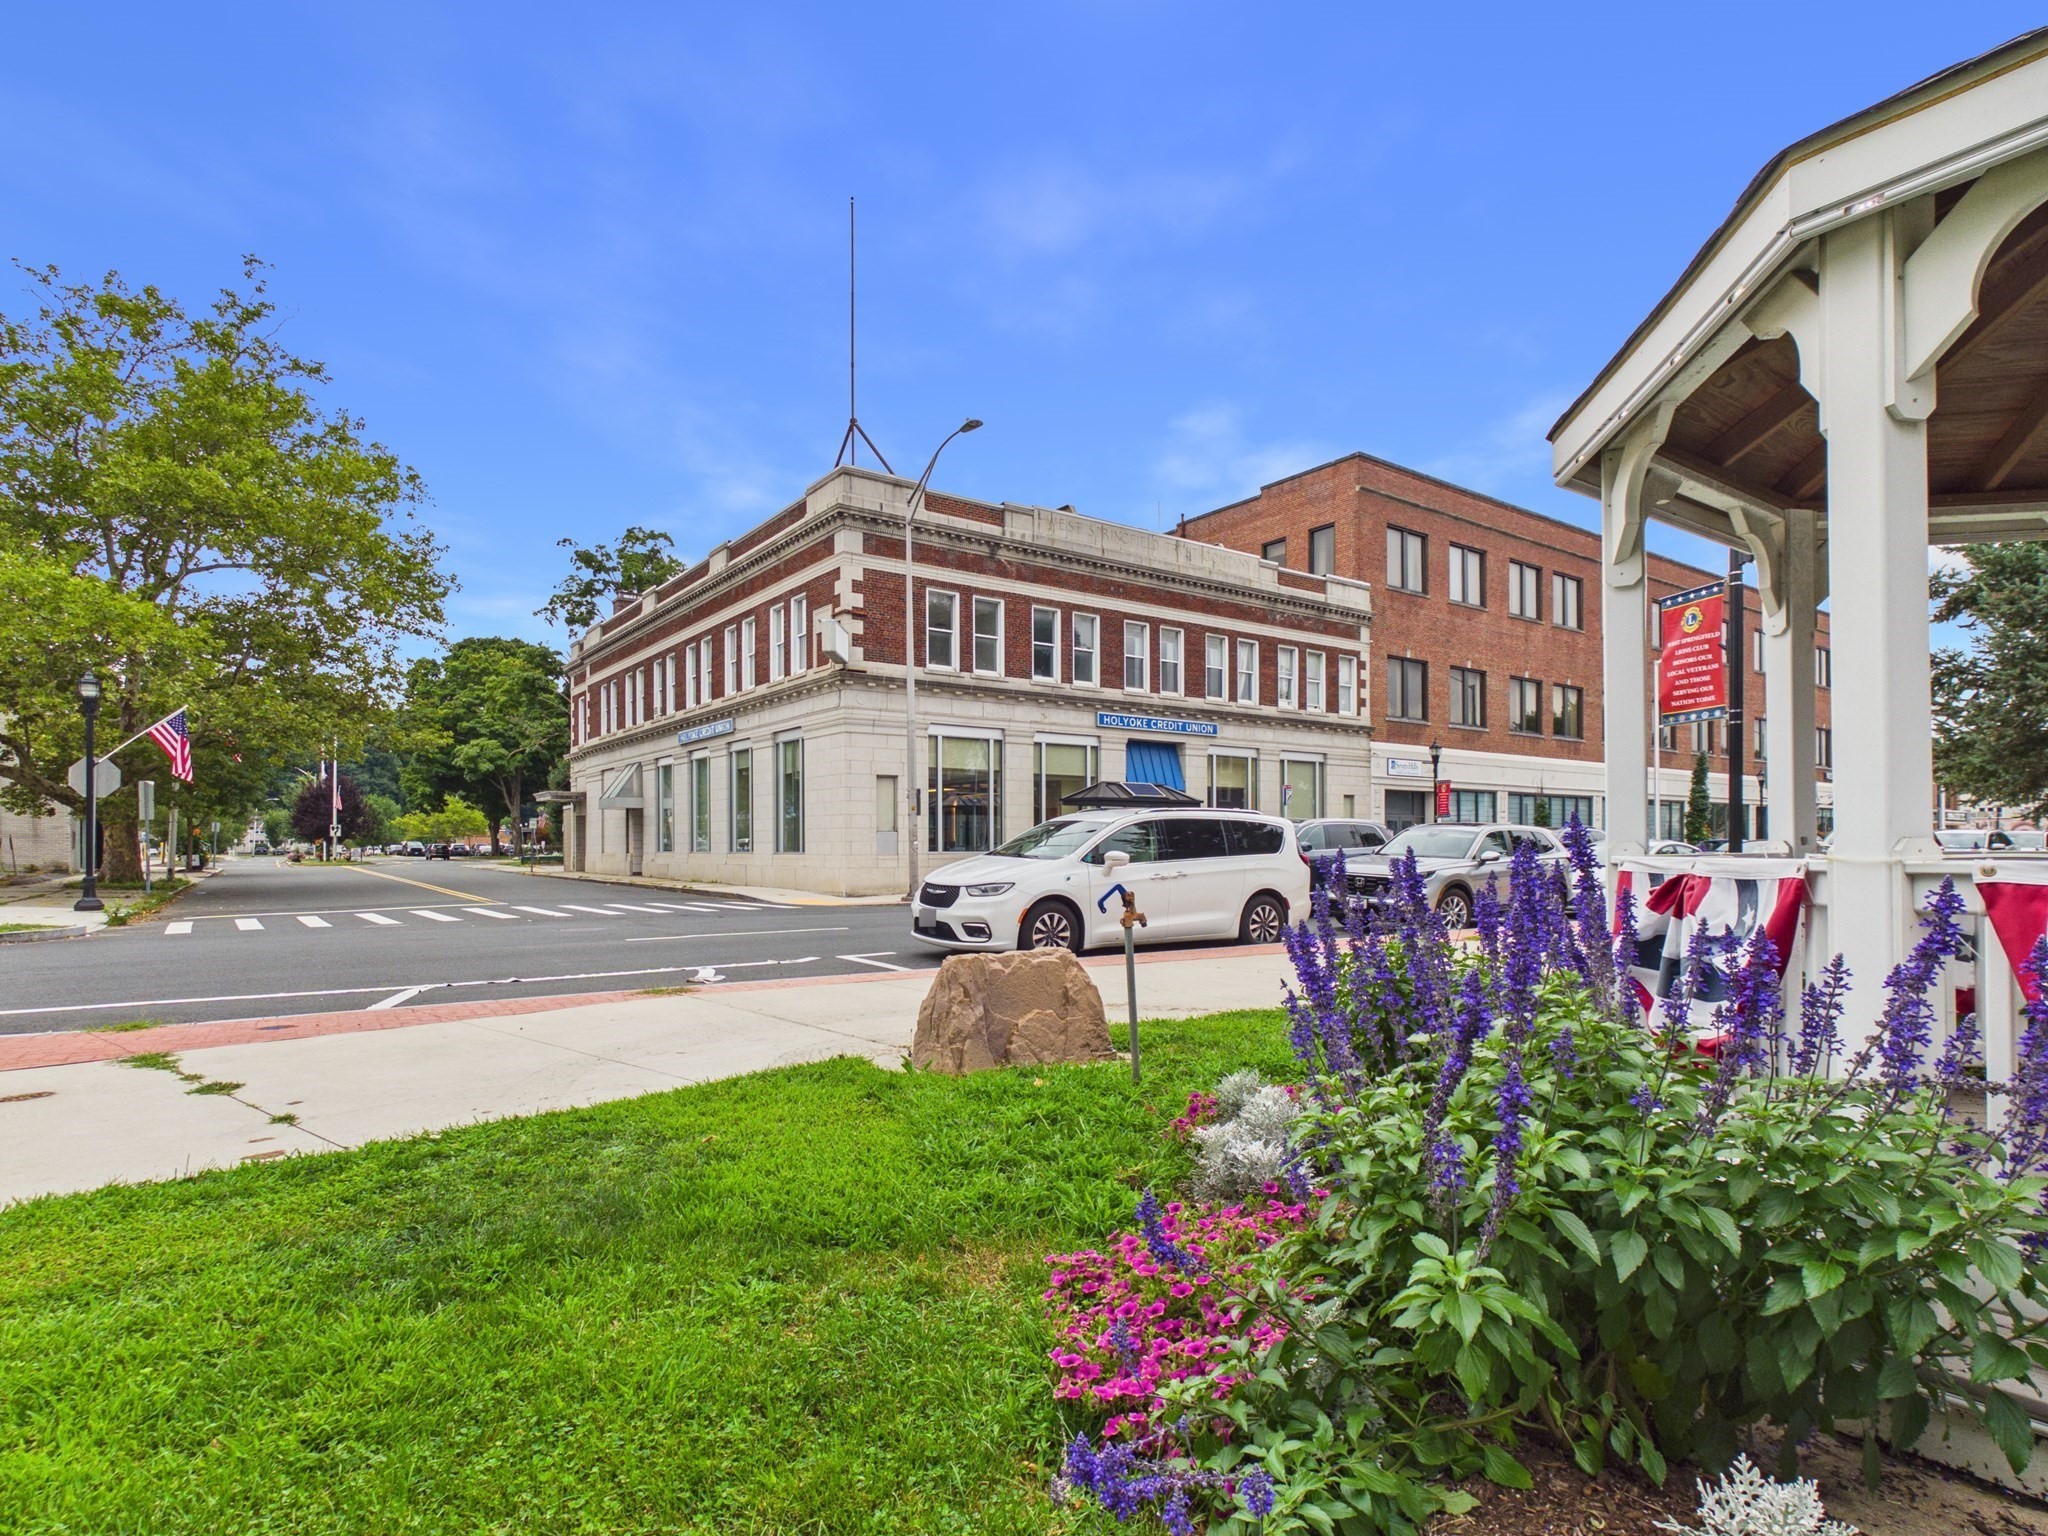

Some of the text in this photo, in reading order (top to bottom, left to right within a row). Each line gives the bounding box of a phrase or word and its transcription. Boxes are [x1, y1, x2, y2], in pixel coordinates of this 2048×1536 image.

[1680, 631, 1720, 644] SPRINGFIELD
[1675, 644, 1709, 655] LIONS CLUB
[1672, 653, 1713, 666] HONORS OUR
[1667, 663, 1719, 677] LOCAL VETERANS
[1675, 674, 1711, 686] AND THOSE
[1672, 687, 1700, 696] SERVING
[1671, 698, 1696, 706] NATION
[1103, 715, 1214, 734] HOLYOKE CREDIT UNION
